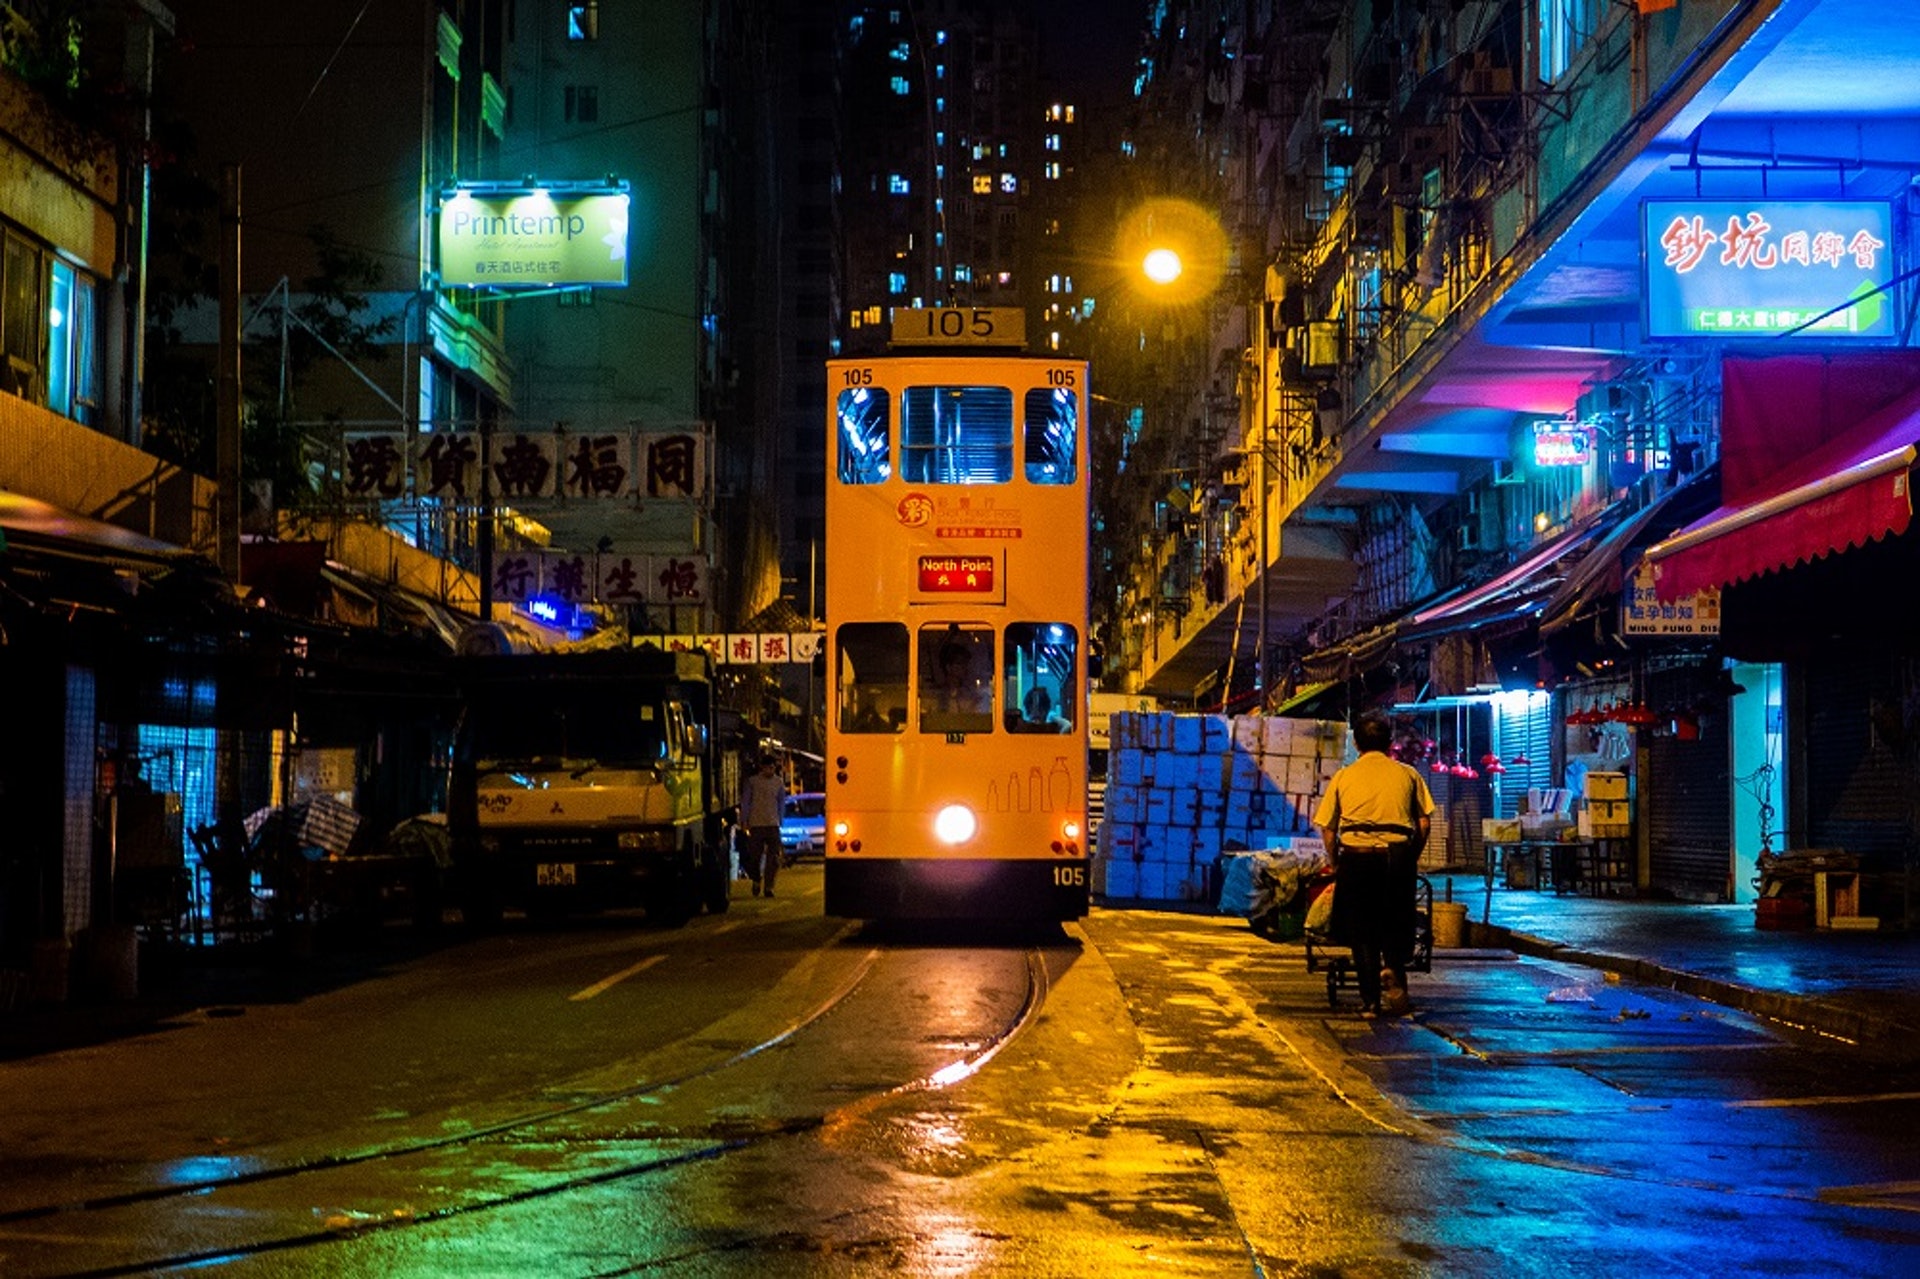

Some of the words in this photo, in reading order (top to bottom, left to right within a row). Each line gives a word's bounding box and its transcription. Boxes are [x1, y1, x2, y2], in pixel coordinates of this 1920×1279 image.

[454, 212, 585, 240] Printemp
[475, 261, 562, 274] 春天酒店式住宅
[927, 311, 994, 337] 105
[843, 368, 873, 385] 105
[1046, 369, 1077, 386] 105
[922, 560, 957, 571] North
[961, 560, 991, 571] Point
[938, 574, 977, 586] 北角
[1628, 624, 1656, 632] MING
[1662, 624, 1692, 632] FUNG
[1053, 865, 1084, 887] 105
